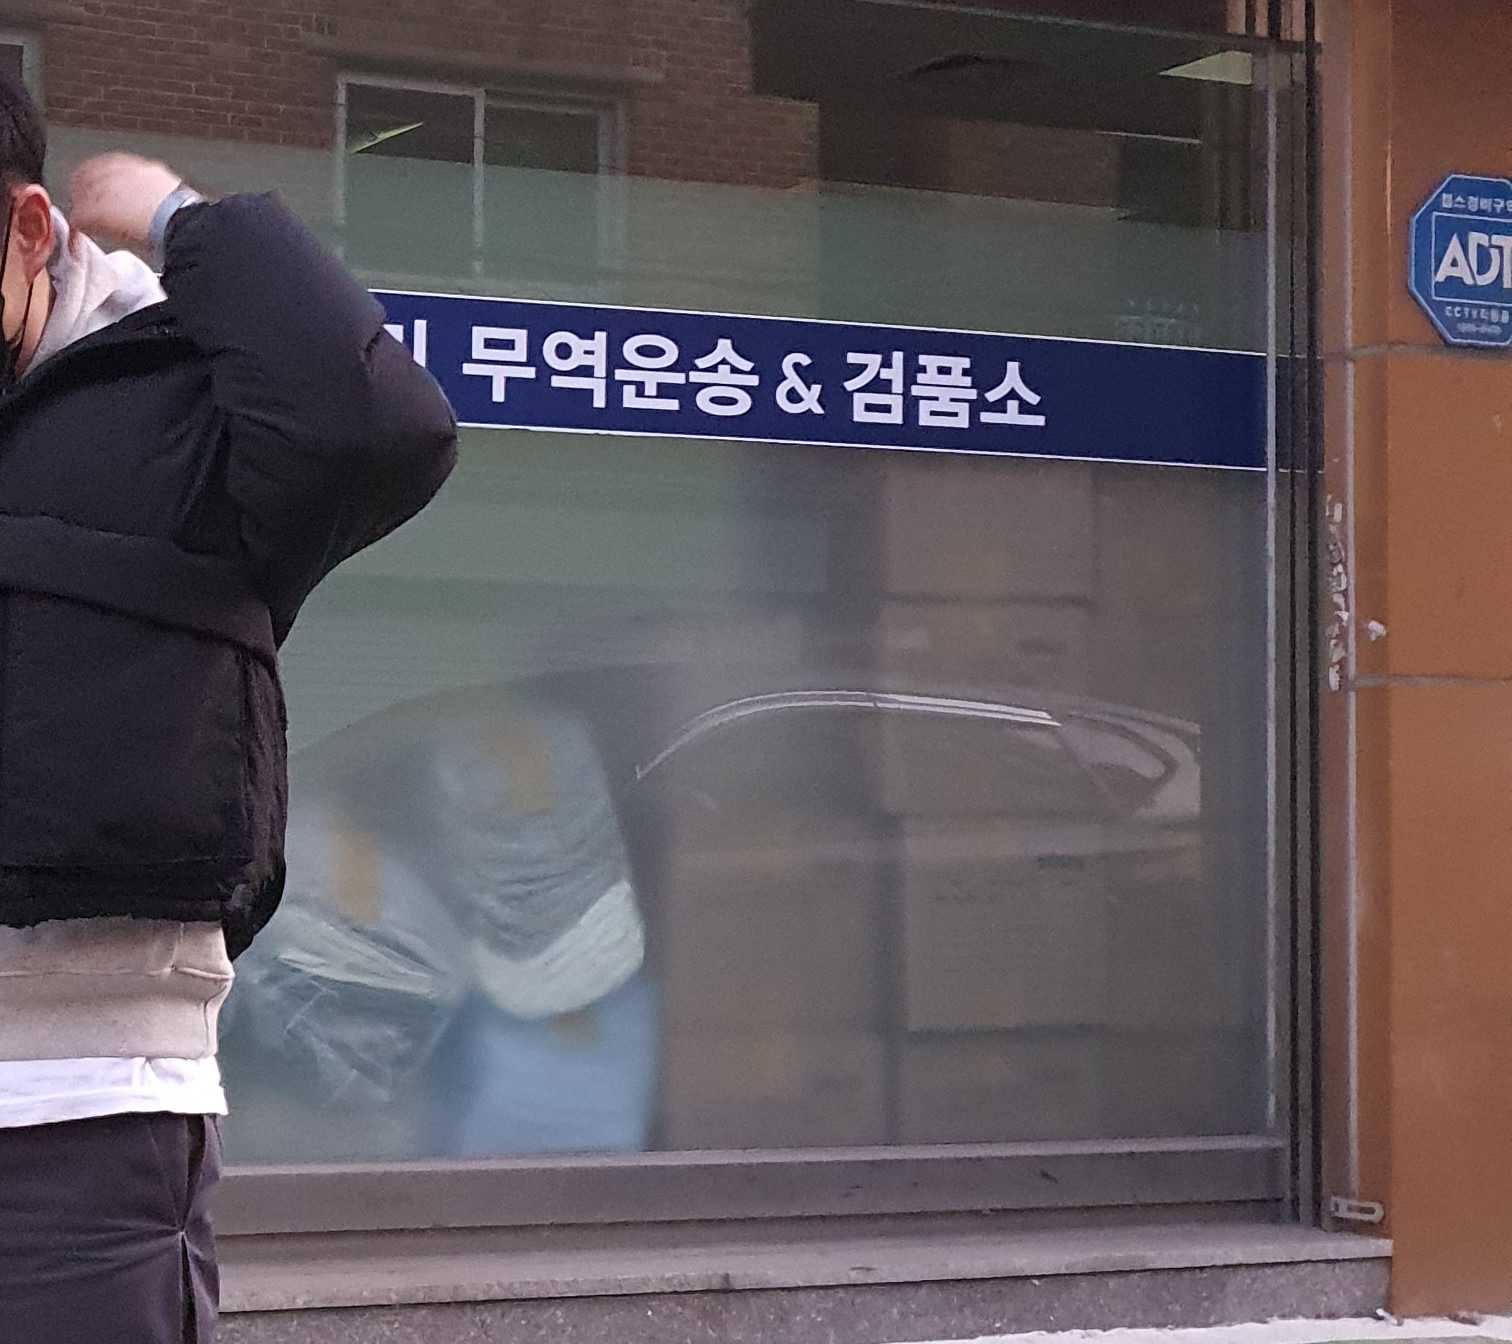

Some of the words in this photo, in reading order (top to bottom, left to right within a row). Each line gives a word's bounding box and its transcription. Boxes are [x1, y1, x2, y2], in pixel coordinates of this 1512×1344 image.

[1434, 231, 1512, 289] ADT
[461, 325, 760, 417] 무역운송
[775, 352, 825, 415] &
[843, 350, 1046, 429] 검품소
